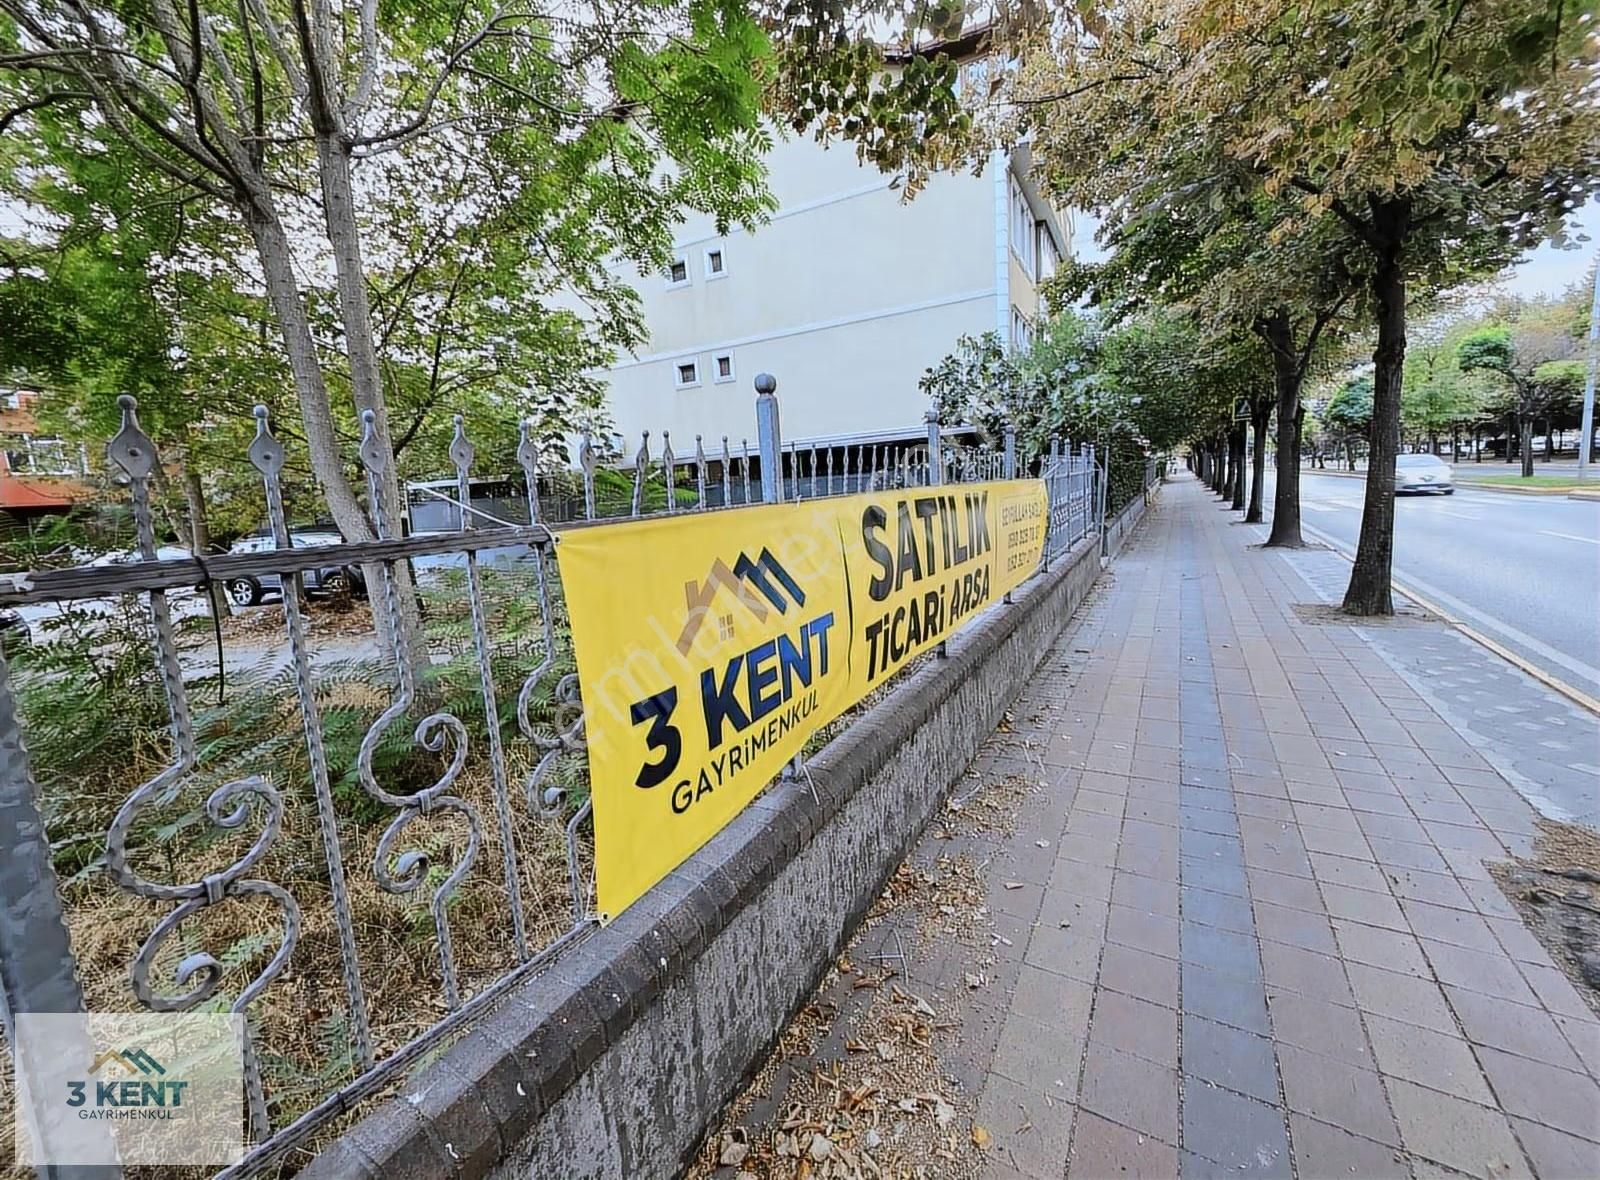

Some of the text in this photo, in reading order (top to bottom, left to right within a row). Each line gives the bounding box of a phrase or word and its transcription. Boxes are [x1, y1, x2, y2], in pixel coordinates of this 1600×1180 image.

[862, 491, 991, 602] SATILIK
[865, 564, 990, 682] TİCARİ ARSA
[630, 612, 835, 789] 3 KENT
[671, 689, 819, 815] GAYRİMENKUL
